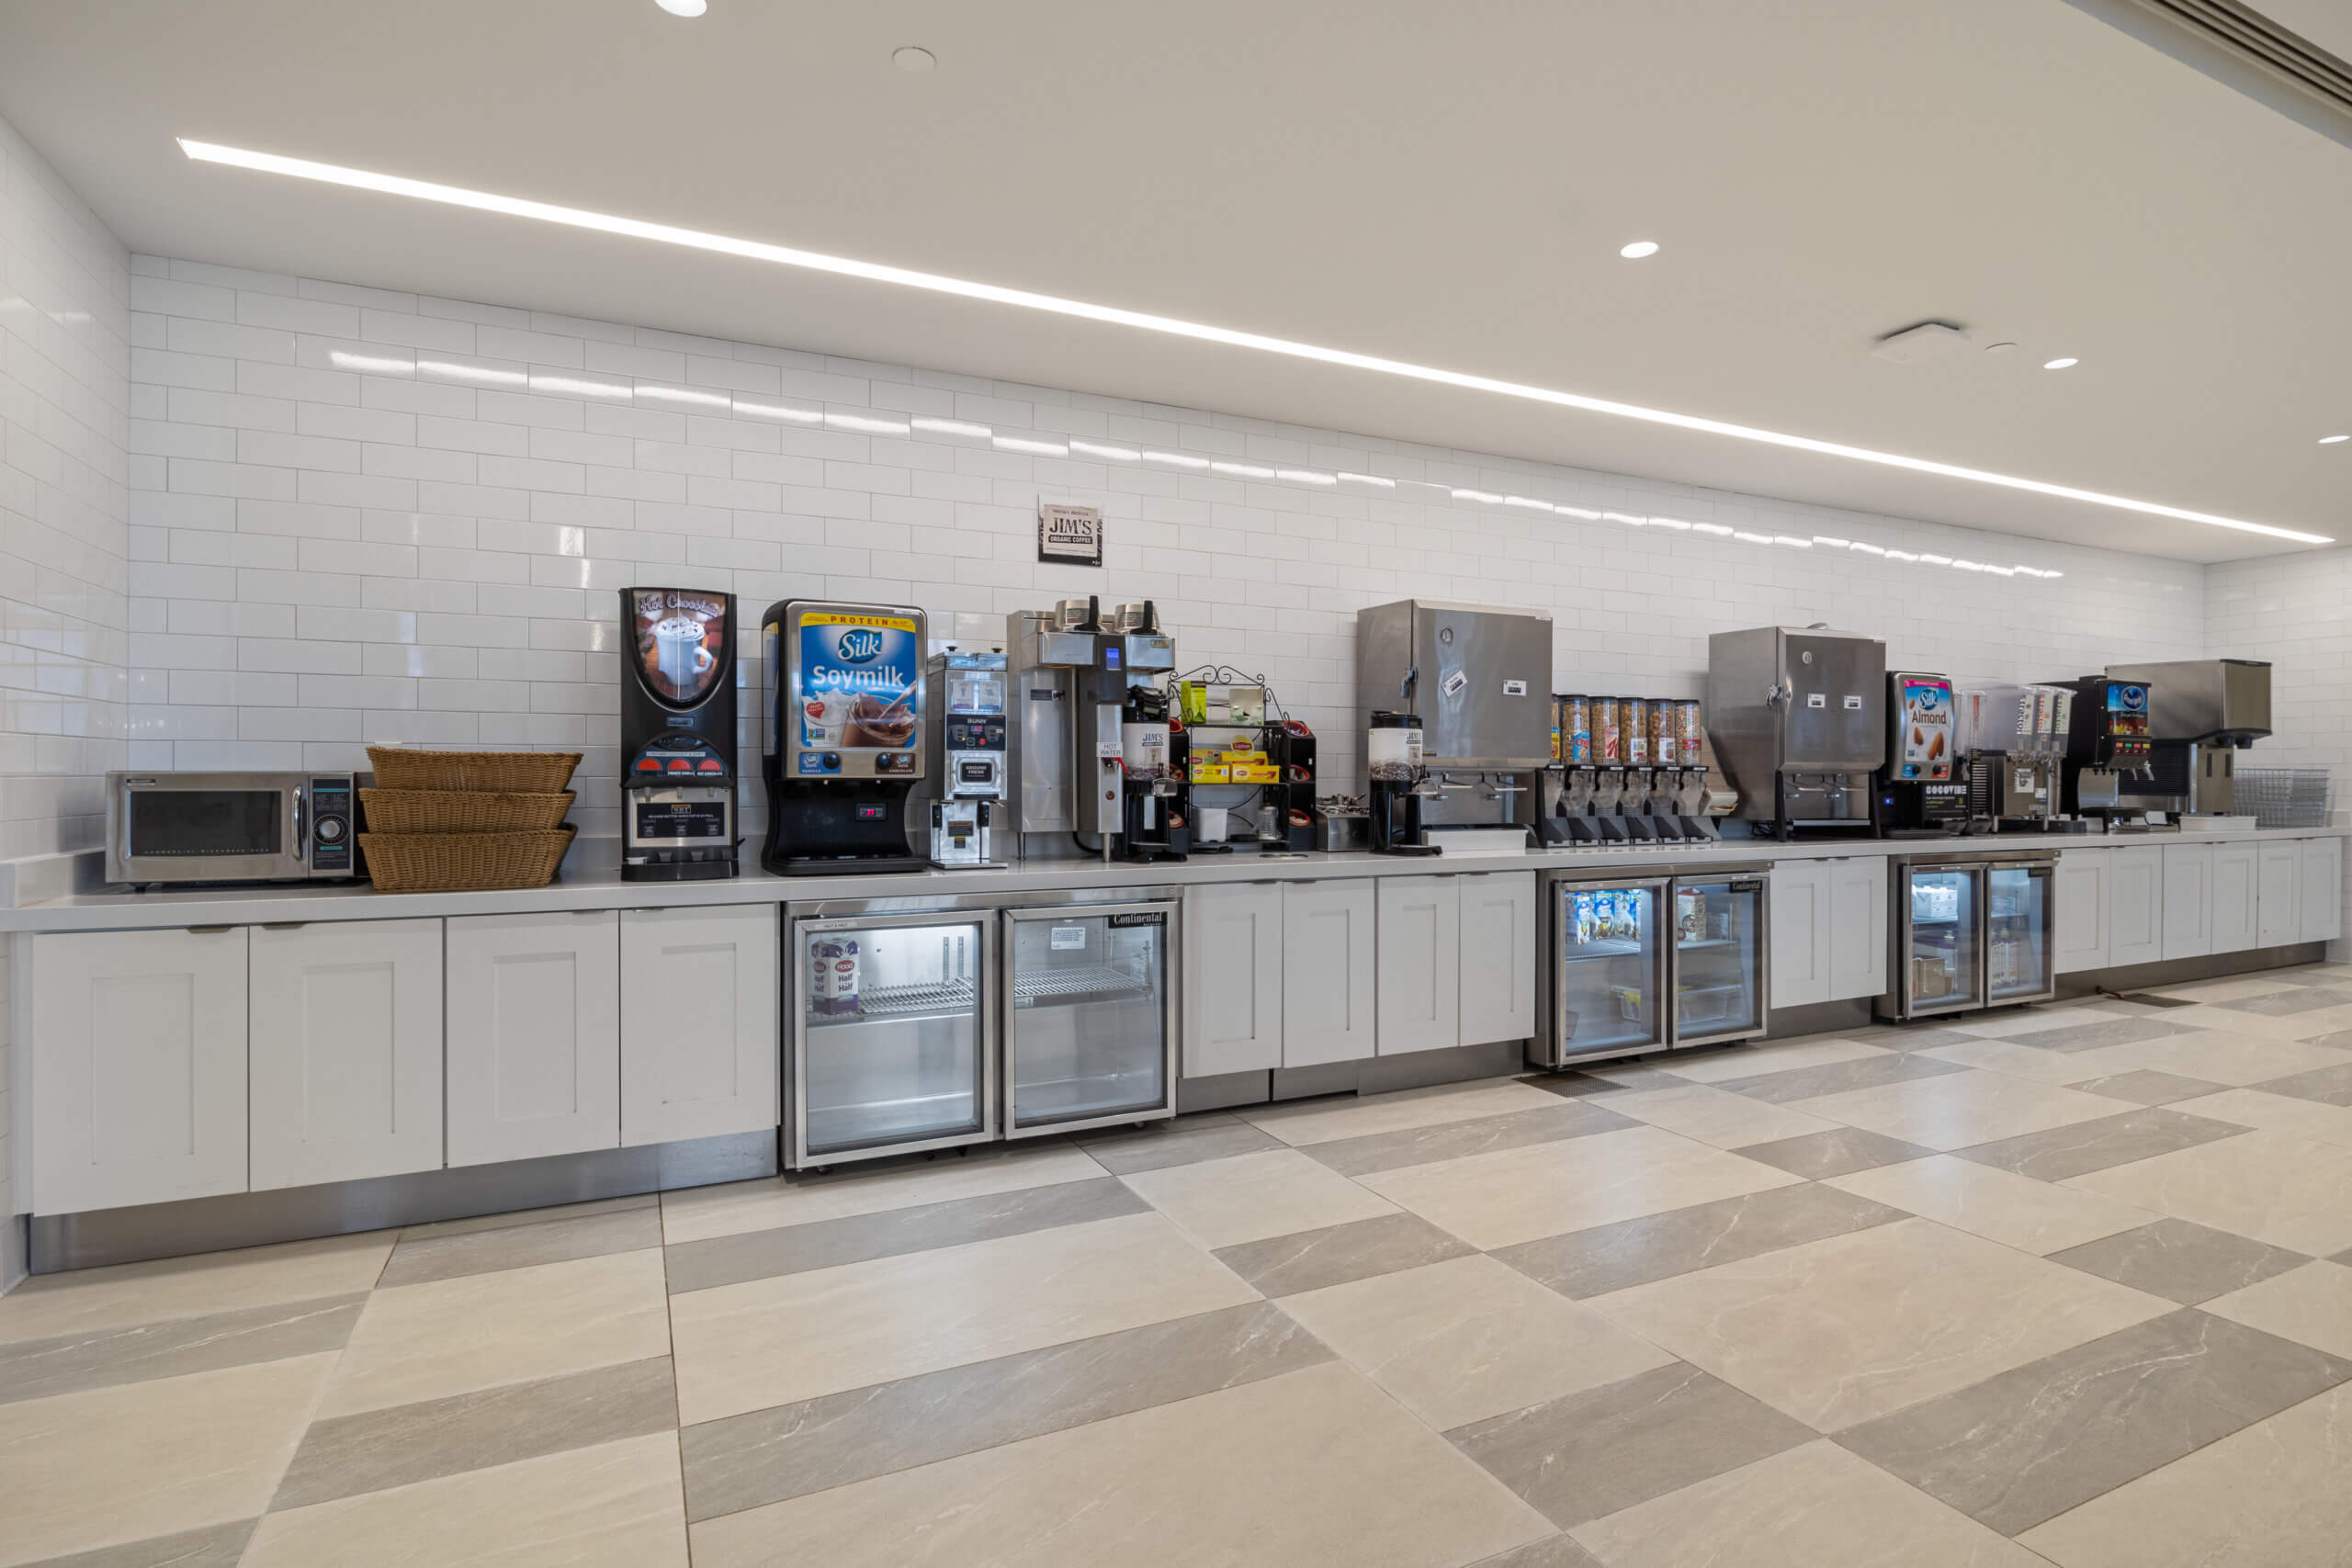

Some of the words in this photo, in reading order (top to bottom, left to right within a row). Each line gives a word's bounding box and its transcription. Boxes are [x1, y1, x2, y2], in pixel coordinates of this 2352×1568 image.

[1049, 517, 1091, 536] JIM'S
[831, 615, 888, 626] PROTEIN
[837, 632, 882, 660] Silk
[812, 665, 905, 689] Soymilk
[1919, 690, 1938, 708] Silk
[1911, 710, 1947, 725] Almond
[1114, 912, 1161, 925] Continental
[838, 973, 854, 983] Half
[838, 983, 854, 993] Half
